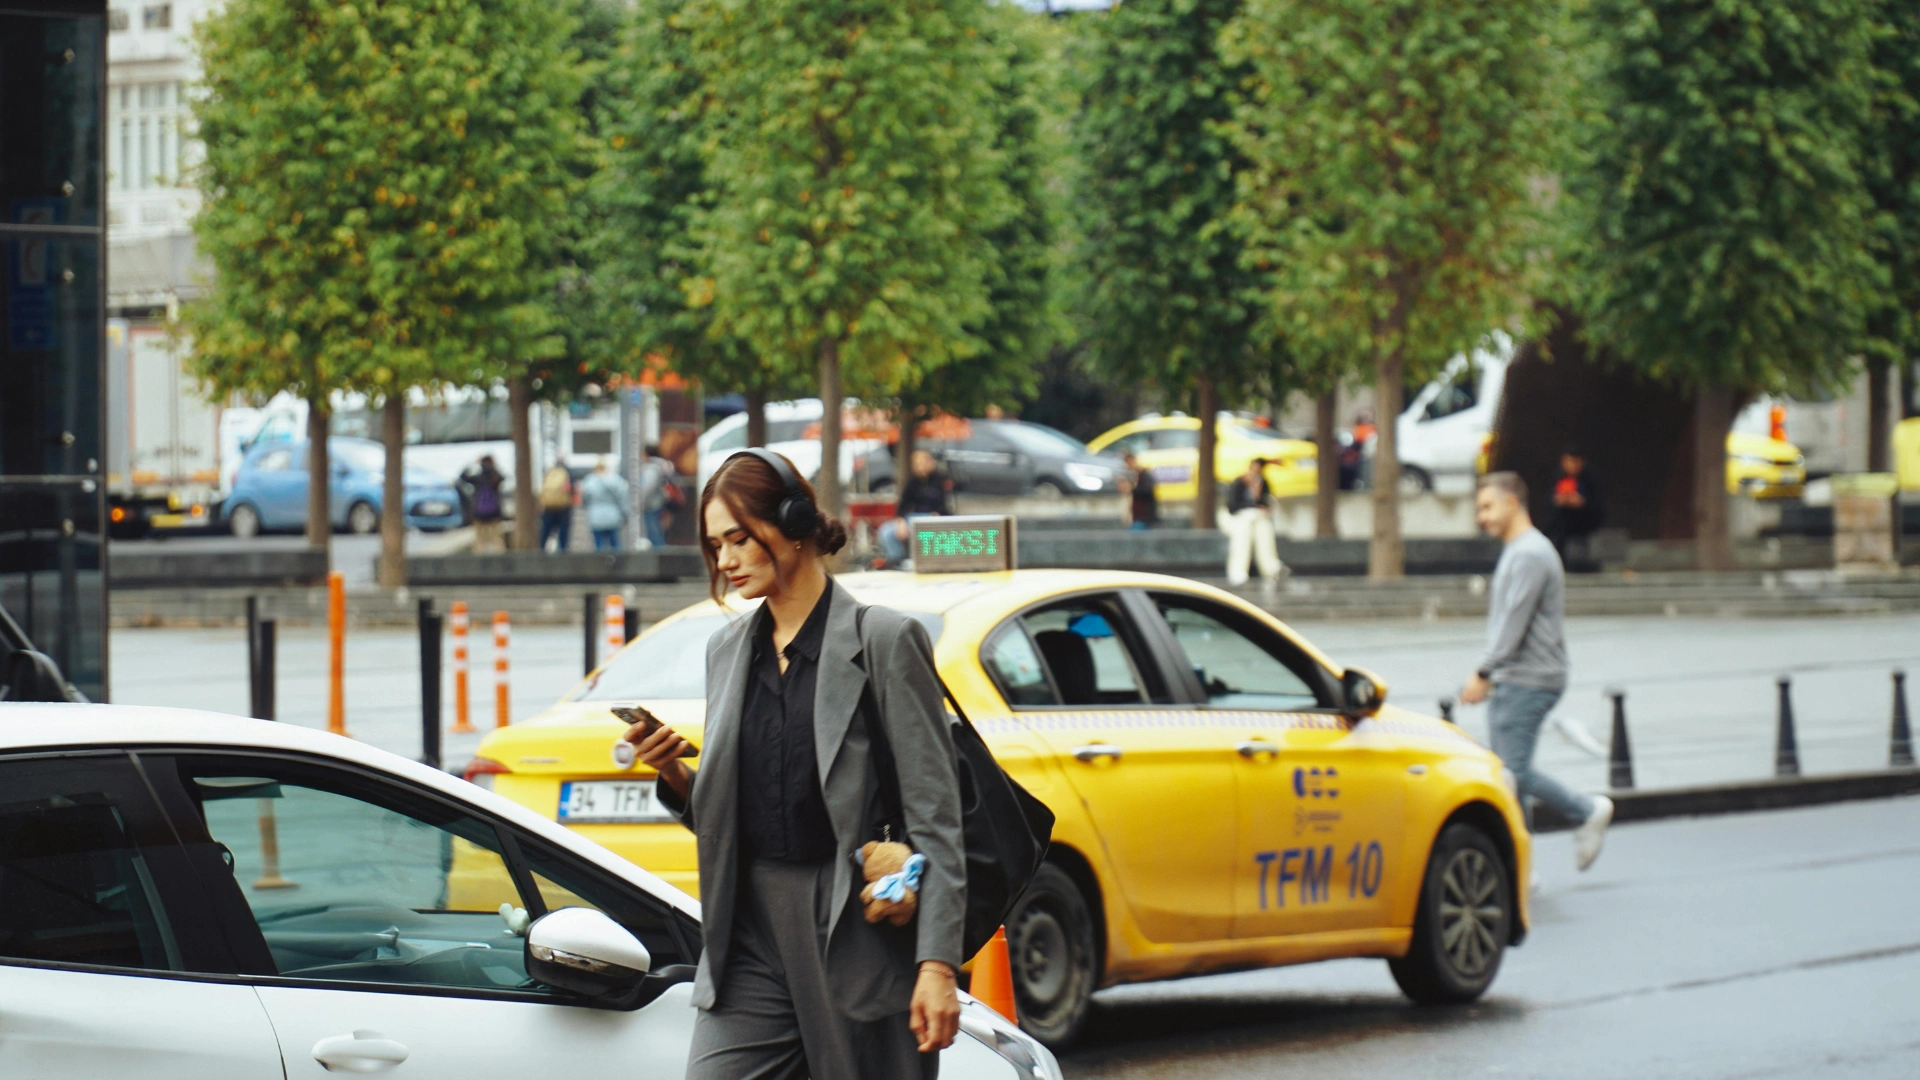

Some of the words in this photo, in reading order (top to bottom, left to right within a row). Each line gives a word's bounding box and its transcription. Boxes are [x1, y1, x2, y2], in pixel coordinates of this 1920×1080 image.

[917, 528, 1000, 556] TAKSI
[572, 786, 596, 812] 34
[613, 785, 652, 812] TFM
[1254, 845, 1334, 910] TFM
[1346, 840, 1384, 899] 10
